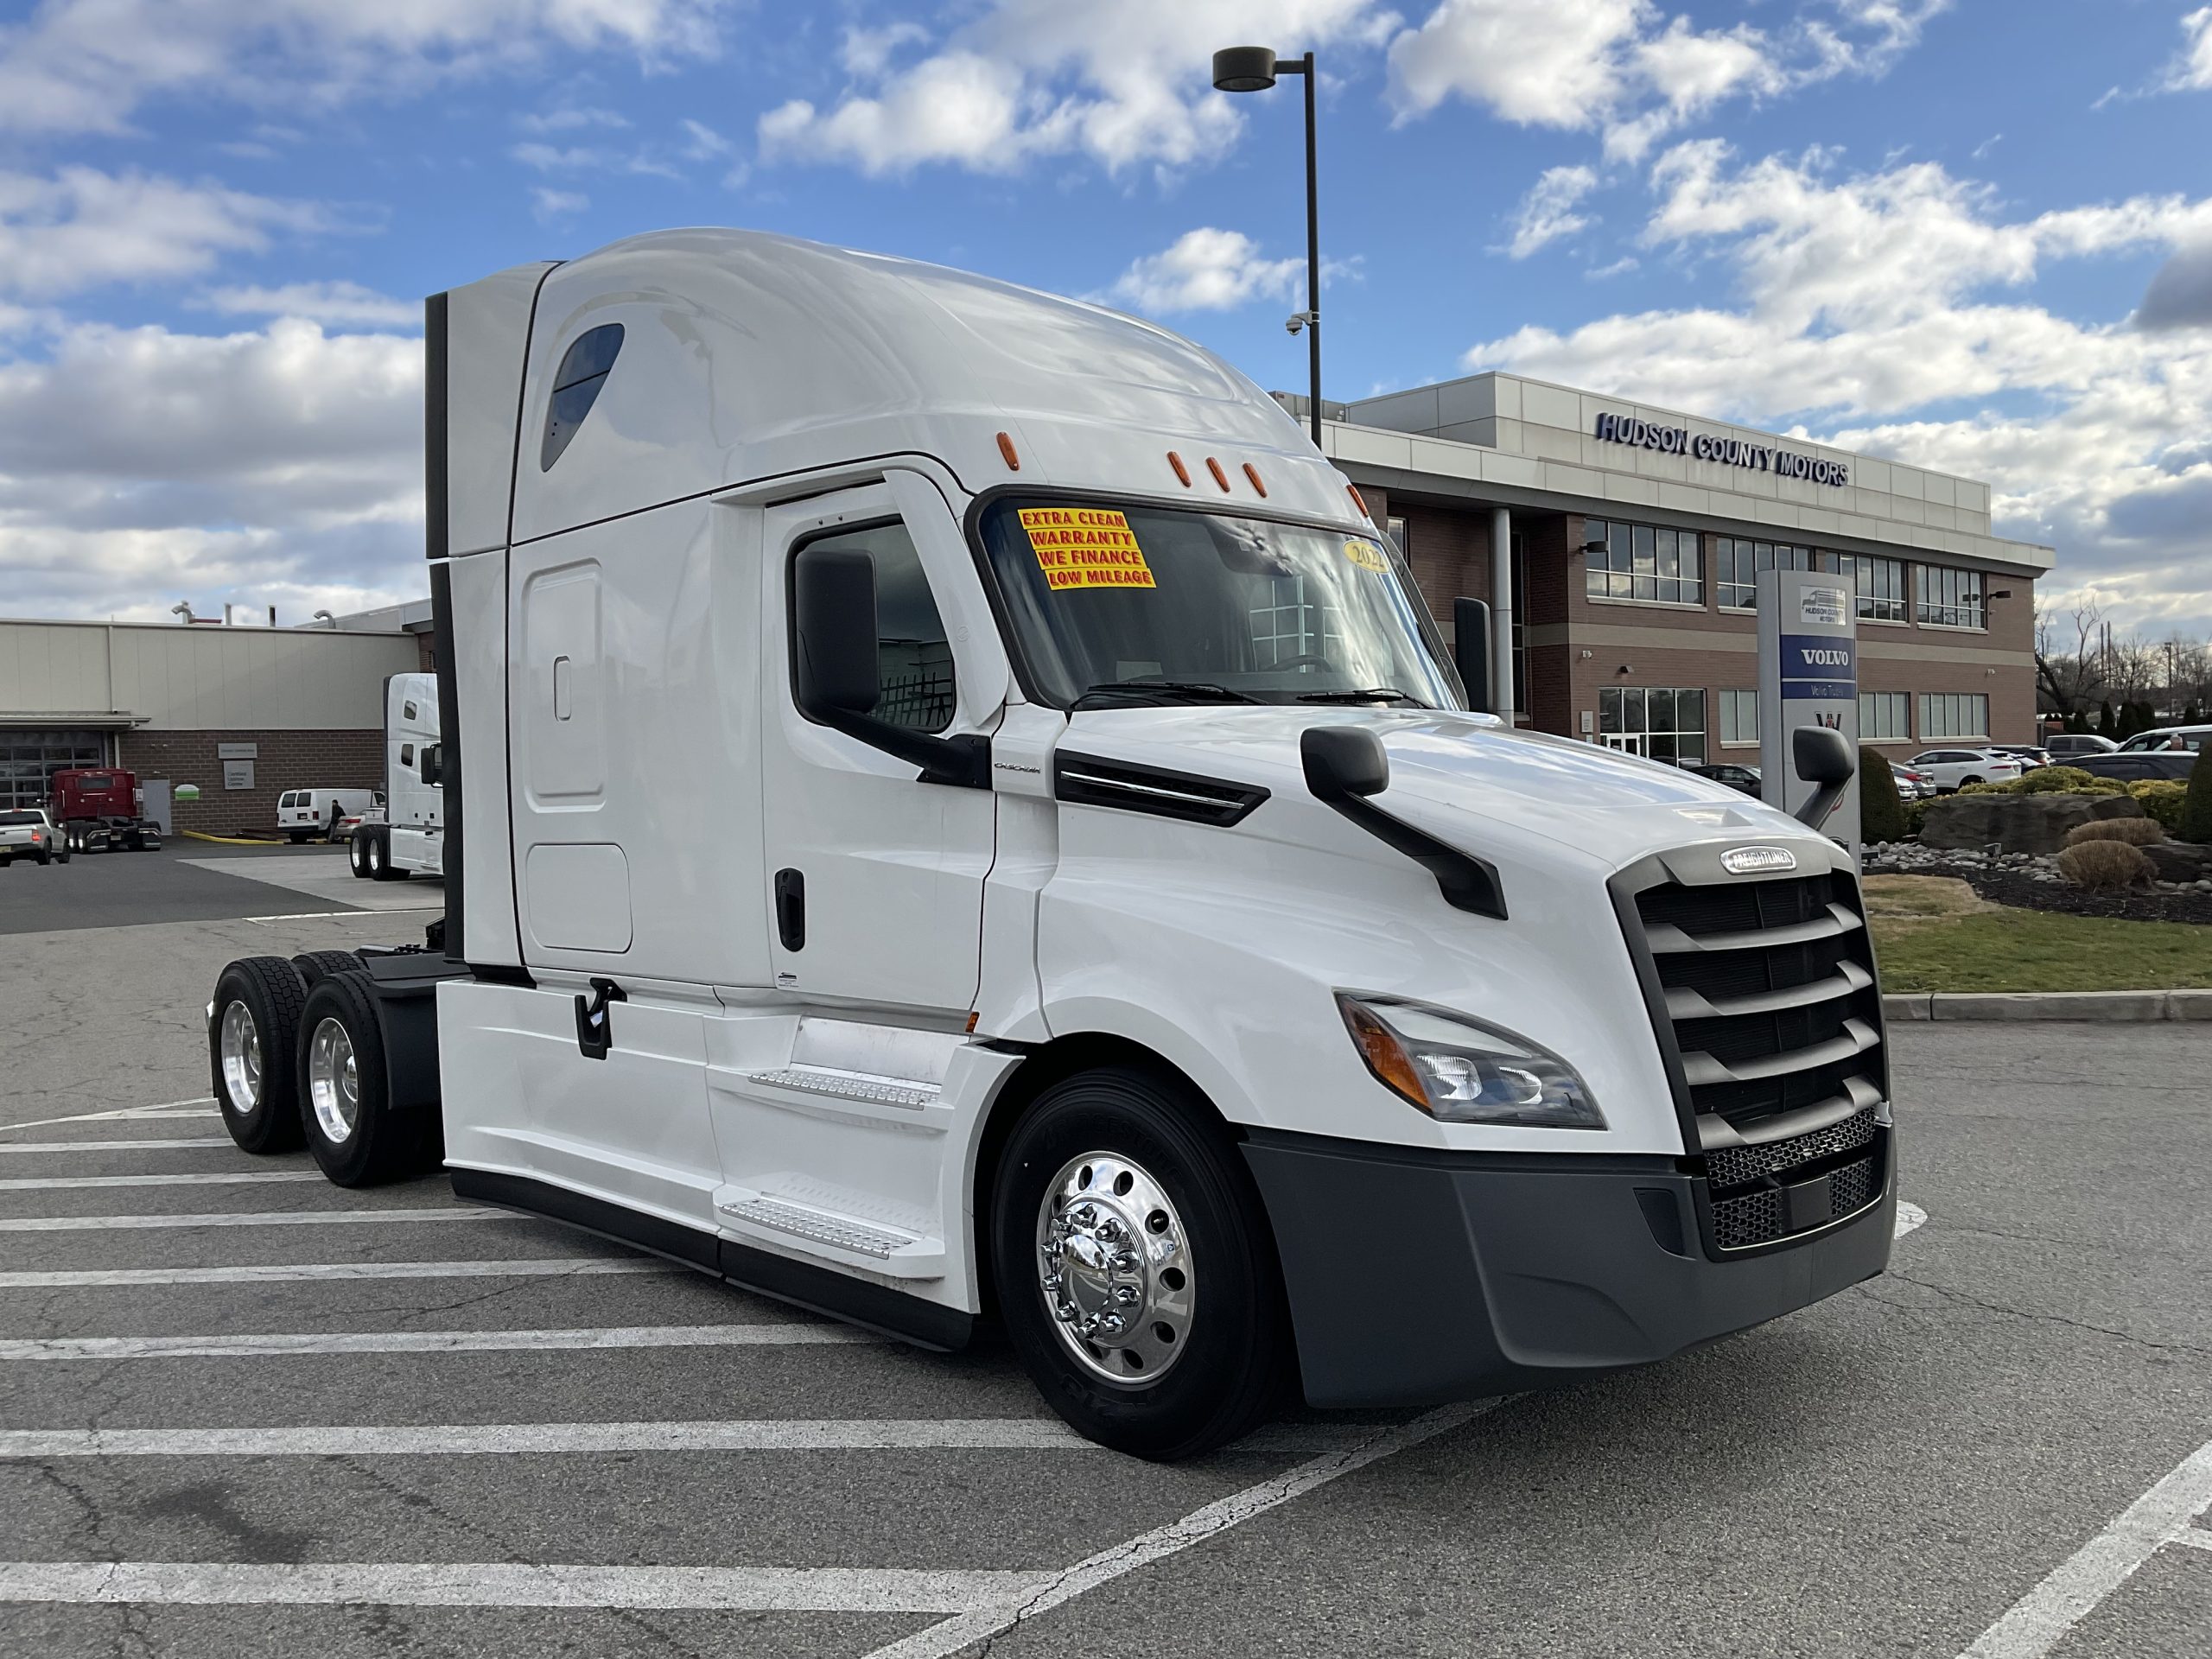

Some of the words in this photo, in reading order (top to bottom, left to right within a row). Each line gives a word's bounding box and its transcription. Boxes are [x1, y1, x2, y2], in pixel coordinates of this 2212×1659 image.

[1598, 412, 1691, 454] HUDSON
[1695, 434, 1777, 470] COUNTY
[1777, 451, 1848, 486] MOTORS
[1022, 512, 1074, 525] EXTRA
[1078, 512, 1126, 527] CLEAN
[1029, 530, 1132, 545] WARRANTY
[1039, 550, 1066, 566] WE
[1071, 550, 1141, 565] FINANCE
[1352, 545, 1384, 568] 2022
[1049, 570, 1082, 586] LOW
[1087, 570, 1152, 584] MILEAGE
[1805, 607, 1827, 615] HUDSON
[1802, 649, 1848, 666] VOLVO
[1732, 851, 1792, 867] FREIGHTLINER
